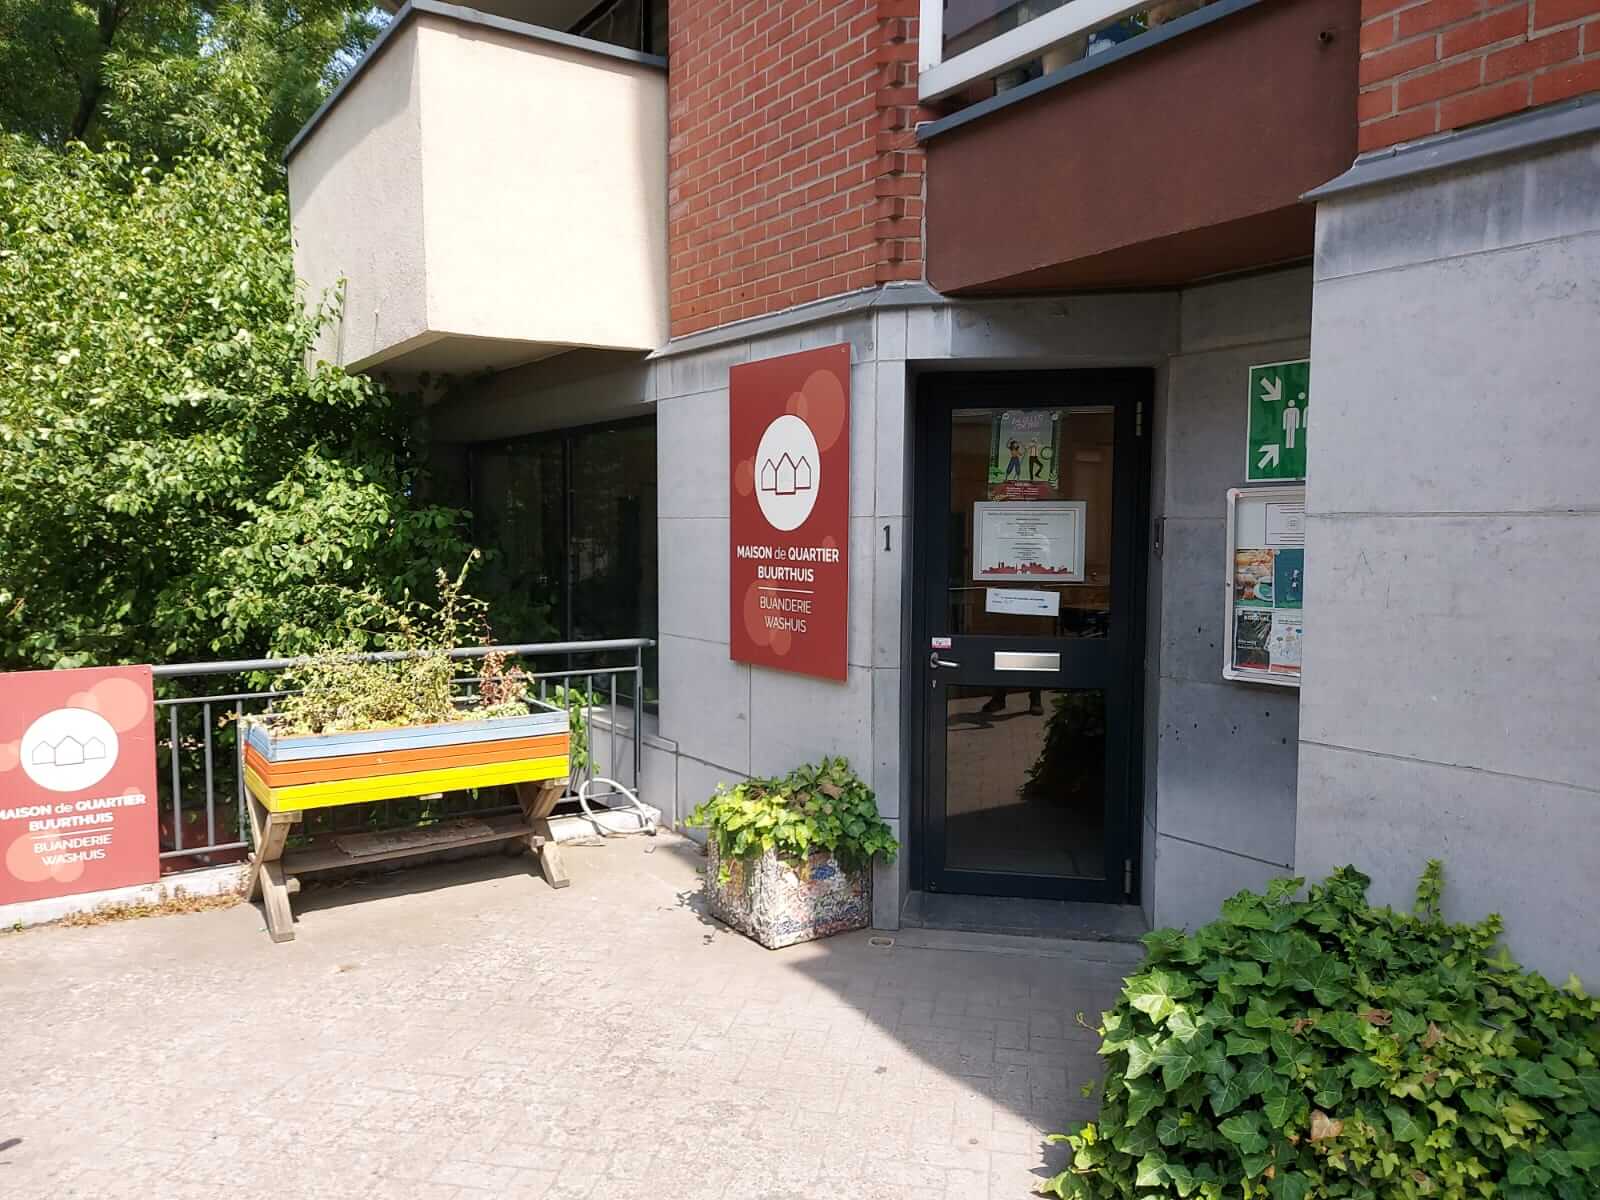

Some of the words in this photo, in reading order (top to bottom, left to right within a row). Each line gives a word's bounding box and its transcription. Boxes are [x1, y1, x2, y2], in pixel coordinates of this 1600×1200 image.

[883, 525, 891, 551] 1
[737, 545, 772, 559] MAISON
[774, 547, 787, 560] de
[787, 547, 839, 562] QUARTIER
[757, 566, 814, 582] BUURTHUIS
[760, 596, 812, 614] BUANDERIE
[764, 616, 807, 633] WASHUIS
[54, 803, 74, 814] de
[75, 794, 146, 811] QUARTIER
[29, 812, 114, 832] BUURTHUIS
[33, 834, 112, 853] BUANDERIE
[41, 848, 106, 865] WASHUIS
